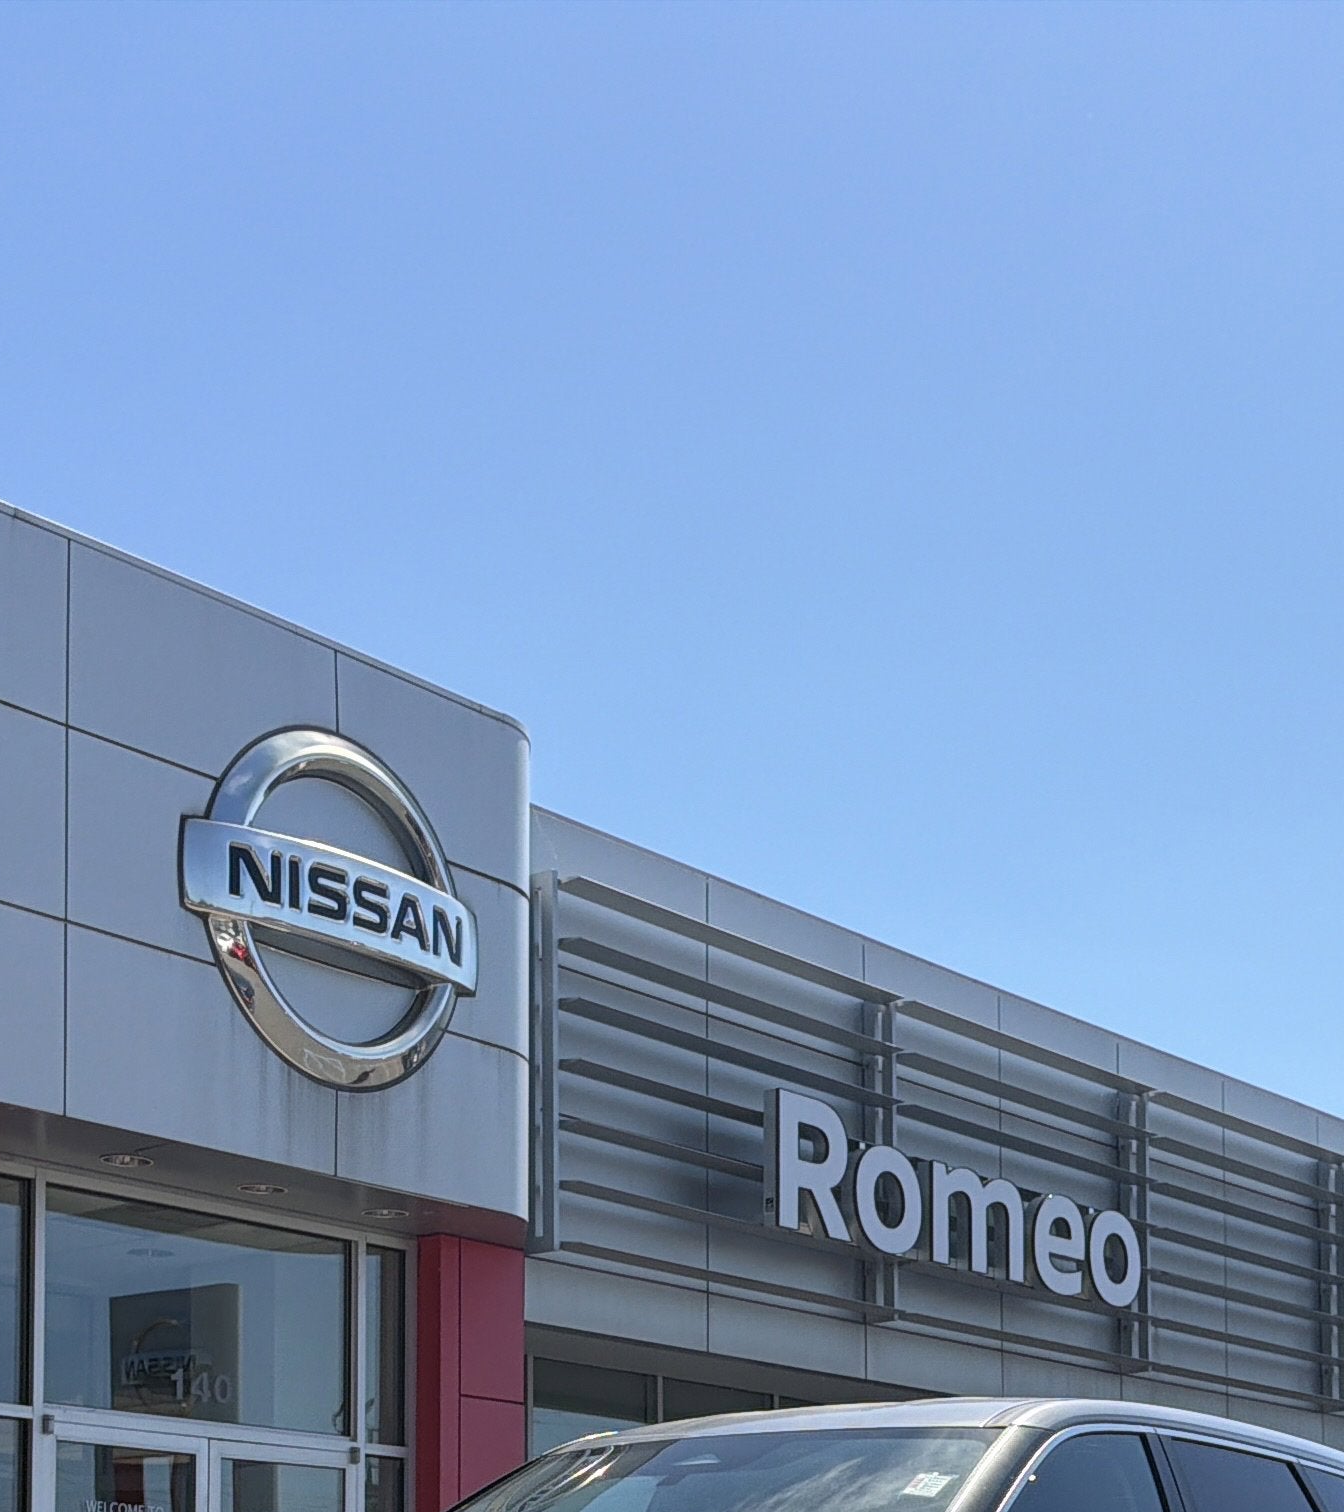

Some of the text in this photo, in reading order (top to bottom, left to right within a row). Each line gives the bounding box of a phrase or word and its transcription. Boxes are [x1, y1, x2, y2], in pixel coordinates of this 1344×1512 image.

[228, 841, 463, 968] NISSAN
[774, 1087, 1142, 1308] Romeo
[171, 1368, 231, 1403] 140
